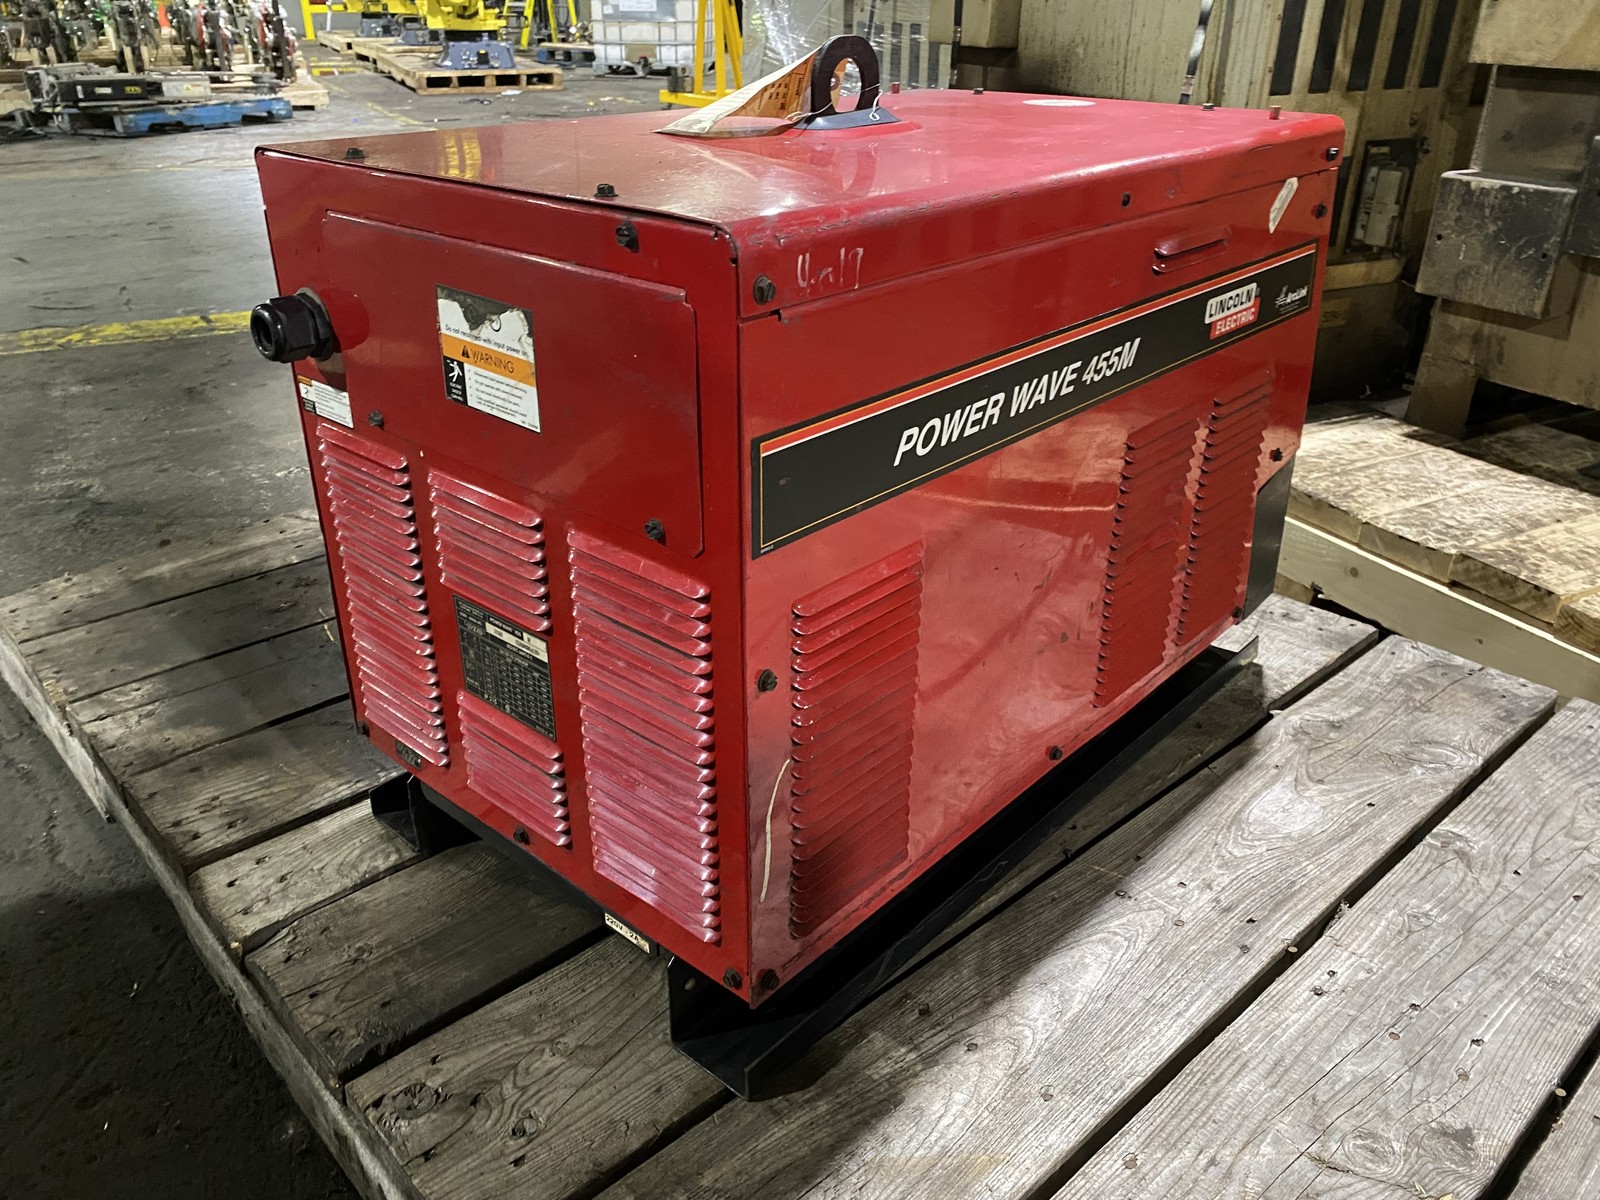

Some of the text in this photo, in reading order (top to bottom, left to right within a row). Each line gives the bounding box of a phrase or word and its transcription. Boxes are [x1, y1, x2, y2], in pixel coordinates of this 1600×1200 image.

[1209, 286, 1254, 319] LINCOLN
[1215, 308, 1256, 335] ELECTRIC
[470, 348, 514, 374] WARNING
[505, 346, 521, 354] power
[893, 337, 1142, 467] POWER WAVE 455M
